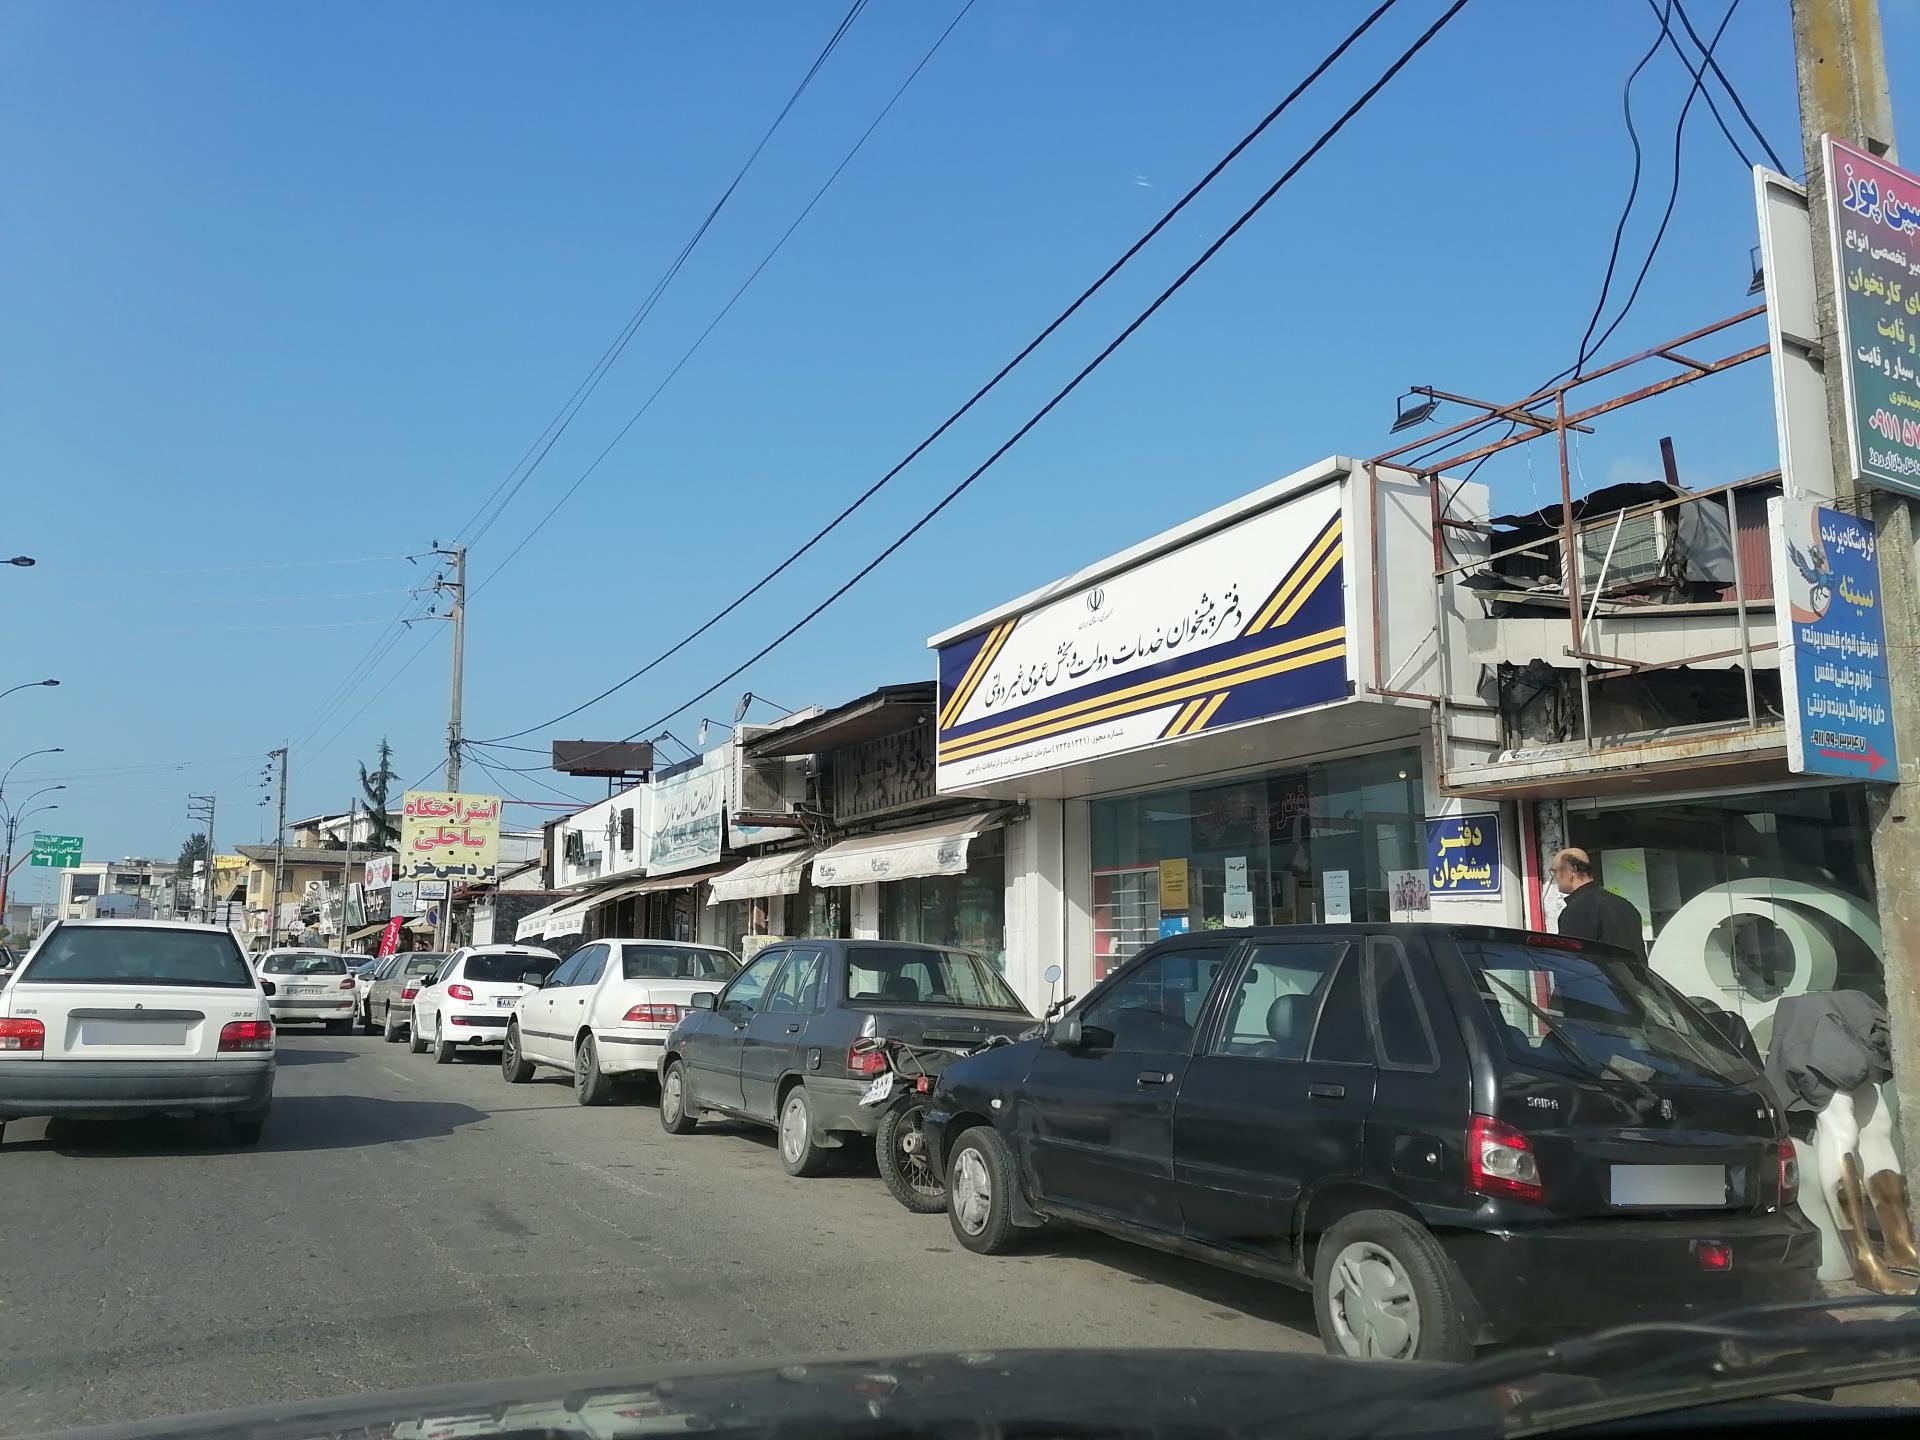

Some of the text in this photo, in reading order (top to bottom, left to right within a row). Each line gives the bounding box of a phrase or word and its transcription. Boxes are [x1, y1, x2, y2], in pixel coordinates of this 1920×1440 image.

[1843, 163, 1881, 224] پوز
[1845, 229, 1869, 252] انواع
[1871, 248, 1906, 267] تخصصی
[1877, 317, 1905, 345] ثابت
[1857, 346, 1914, 381] سیار و ثابت
[1868, 408, 1901, 443] ۰۹۱۱
[1821, 524, 1875, 561] فروشگاه پرنده
[1166, 593, 1216, 649] پیشخوان
[1208, 582, 1242, 640] دفتر
[1112, 627, 1163, 665] خدمات
[1801, 625, 1879, 660] فروش انواع قفس پرنده
[1045, 641, 1073, 686] بخش
[1069, 641, 1108, 679] دولت
[985, 672, 1005, 708] دولتی
[1002, 664, 1024, 706] غیر
[1021, 662, 1048, 696] عمومی
[1814, 662, 1872, 696] لوازم جانبی قفس
[1807, 693, 1885, 726] دان و خوراک پرنده زینتی
[1107, 728, 1124, 739] شماره
[1003, 755, 1021, 765] مقررات
[1020, 751, 1034, 763] تنظیم
[1034, 746, 1051, 757] سازمان
[413, 827, 486, 852] ساحلی
[1437, 820, 1482, 856] دفتر
[399, 857, 437, 879] خزر
[436, 862, 496, 883] پردیس
[1433, 857, 1491, 888] پیشخوان
[1527, 1096, 1559, 1110] SAIPA
